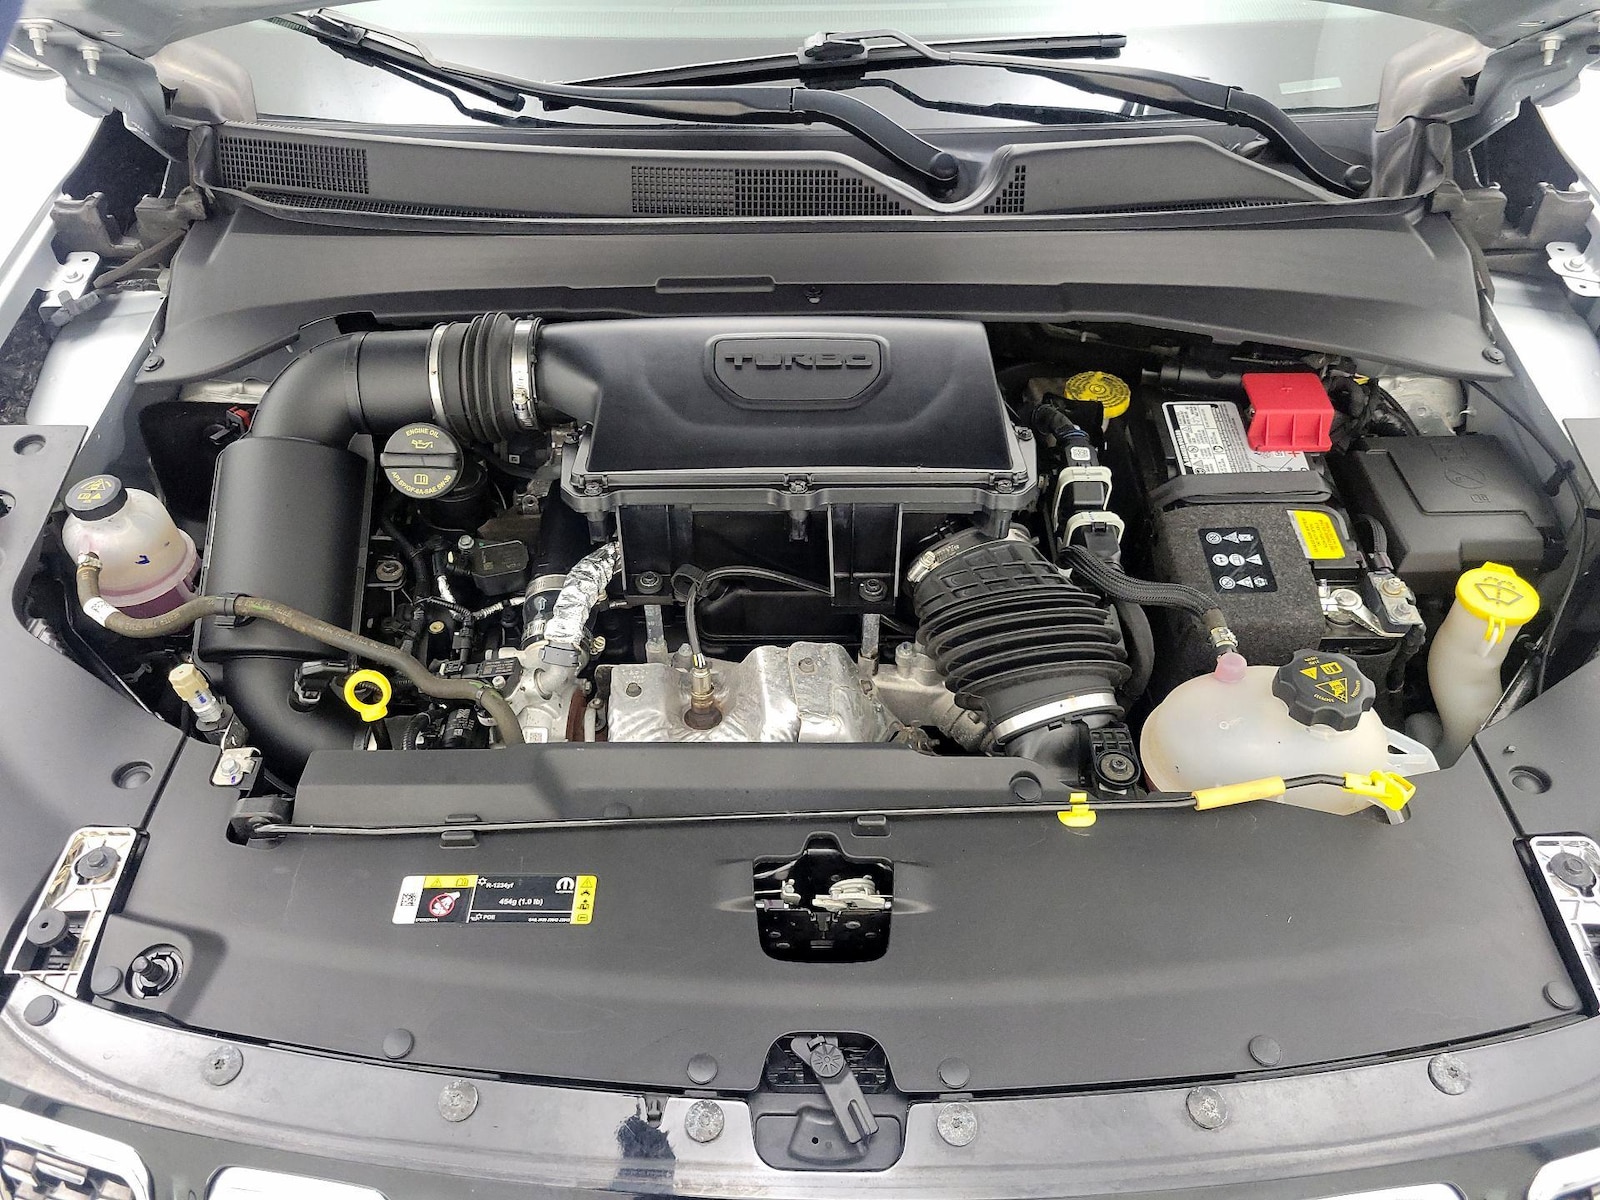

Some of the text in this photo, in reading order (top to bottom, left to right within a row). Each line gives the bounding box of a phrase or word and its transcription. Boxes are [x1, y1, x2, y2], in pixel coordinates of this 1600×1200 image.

[724, 352, 873, 371] TURBO
[405, 428, 440, 438] ENGINE OIL
[392, 472, 400, 482] API
[437, 475, 451, 489] 5W-30
[498, 898, 544, 906] 454g (1.0 lb)
